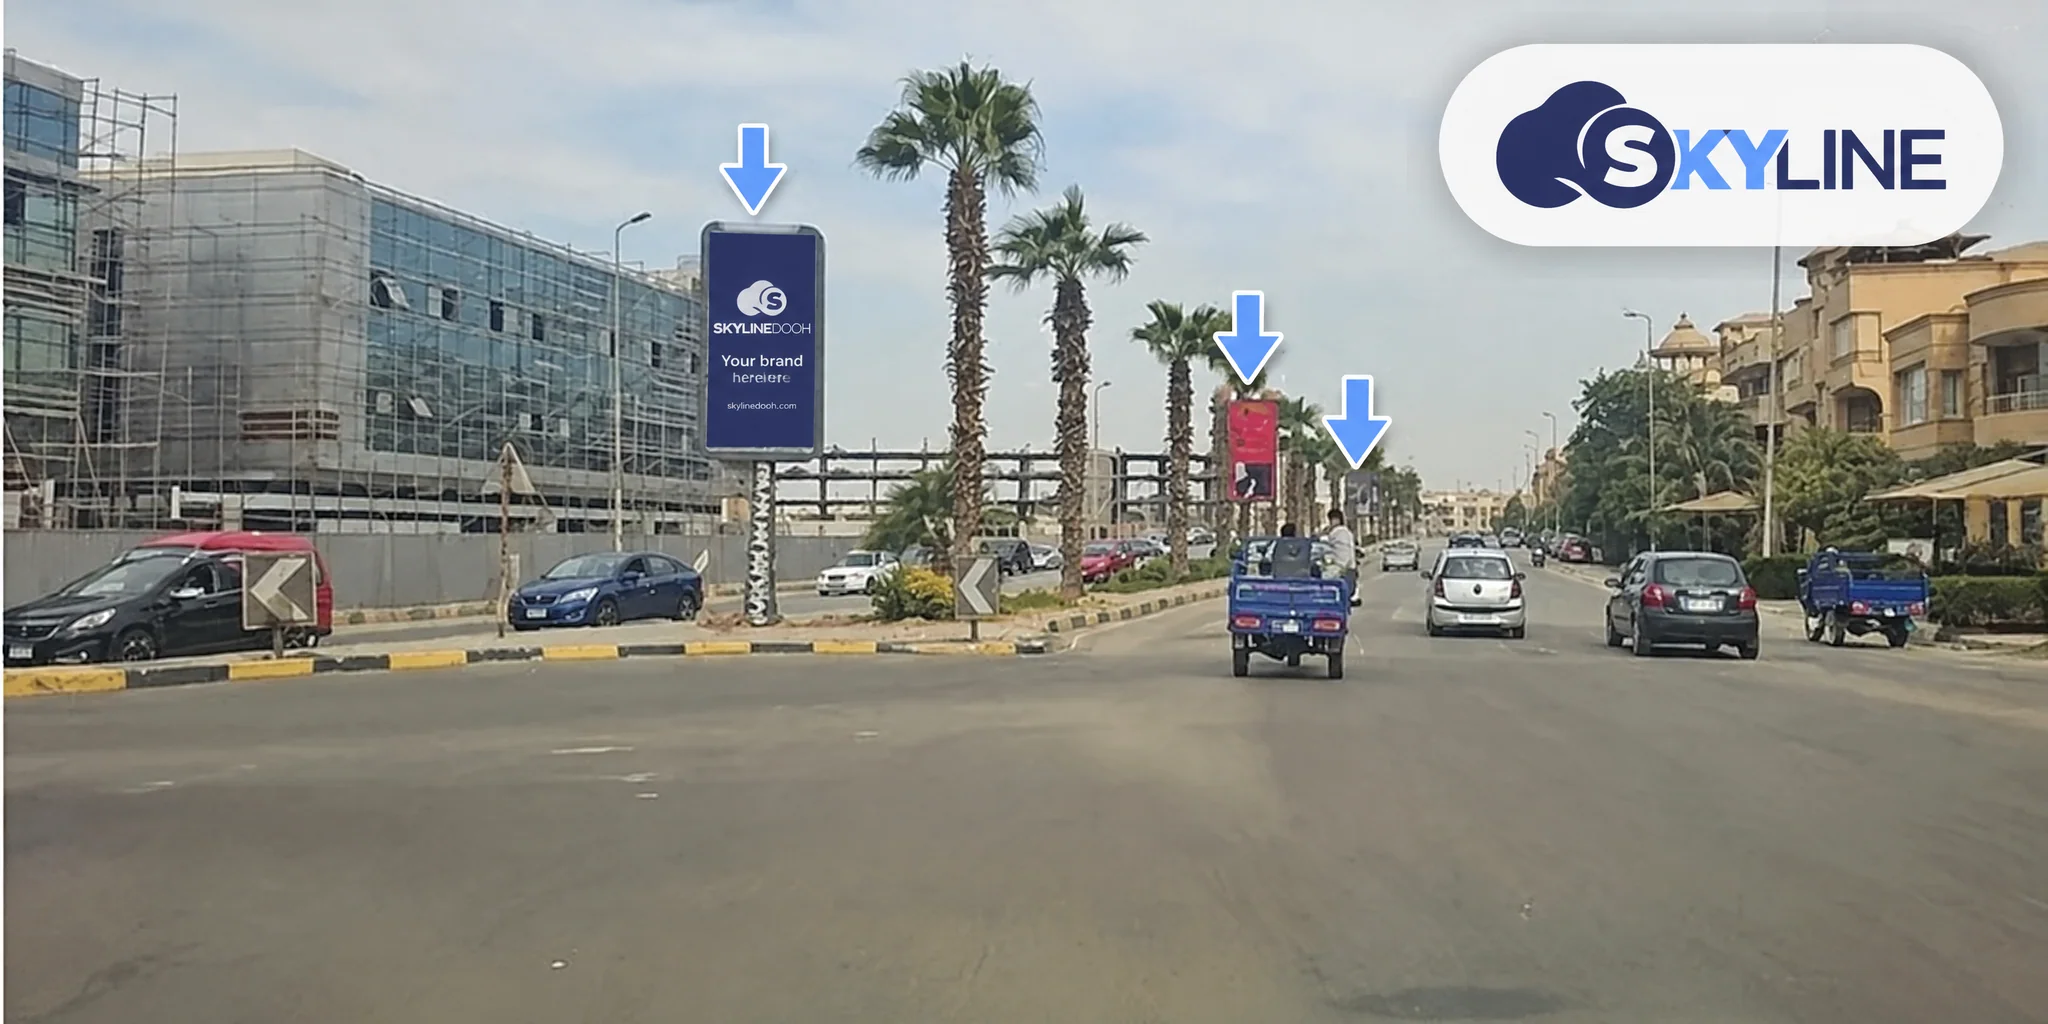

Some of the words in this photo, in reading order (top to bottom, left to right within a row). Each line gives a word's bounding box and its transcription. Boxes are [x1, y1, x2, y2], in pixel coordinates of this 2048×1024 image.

[766, 292, 782, 310] S
[713, 322, 811, 334] SKYLINEDOOH
[721, 354, 757, 367] Your
[760, 354, 803, 367] brand
[727, 401, 797, 412] skylinedooh.com
